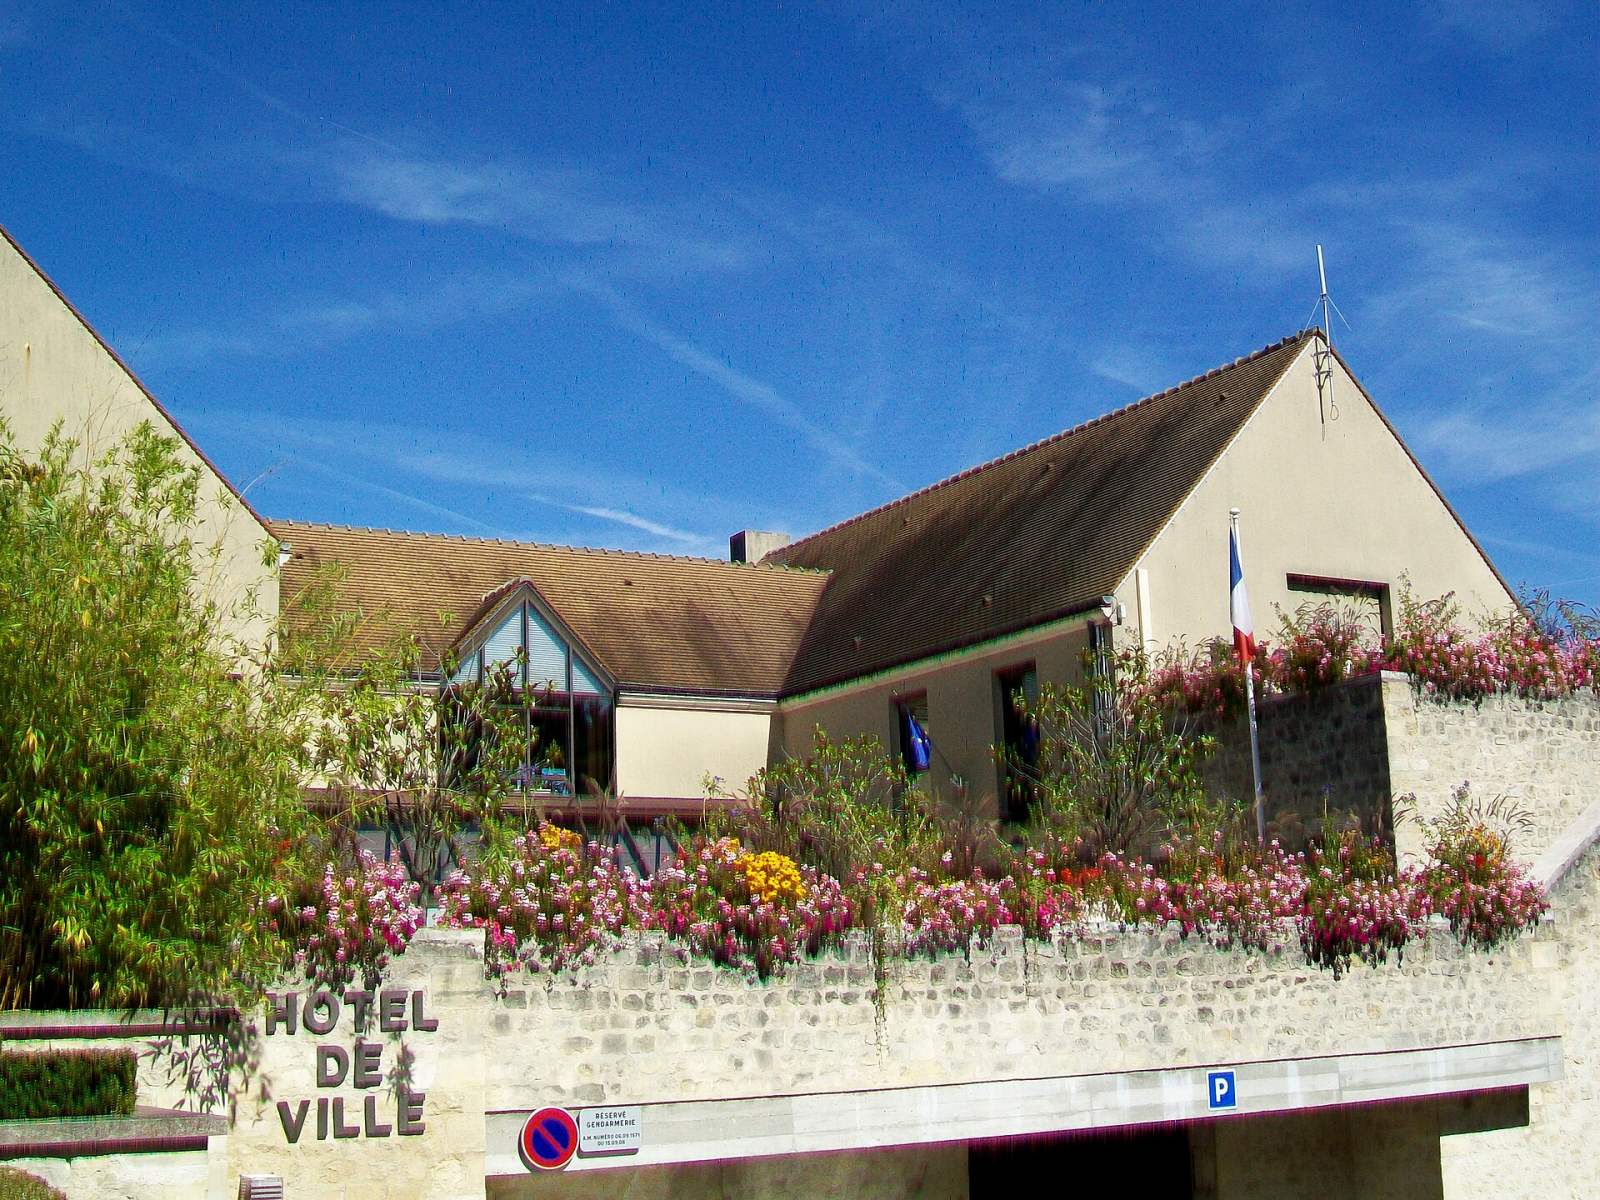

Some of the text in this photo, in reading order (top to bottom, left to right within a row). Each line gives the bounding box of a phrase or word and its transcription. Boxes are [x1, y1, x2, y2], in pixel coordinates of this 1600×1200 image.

[265, 990, 439, 1035] HOTEL
[316, 1043, 384, 1089] DE
[1214, 1077, 1229, 1103] P
[276, 1093, 426, 1144] VILLE
[586, 1119, 636, 1128] GENDARMERIE
[595, 1111, 626, 1119] RÉSERVÉ
